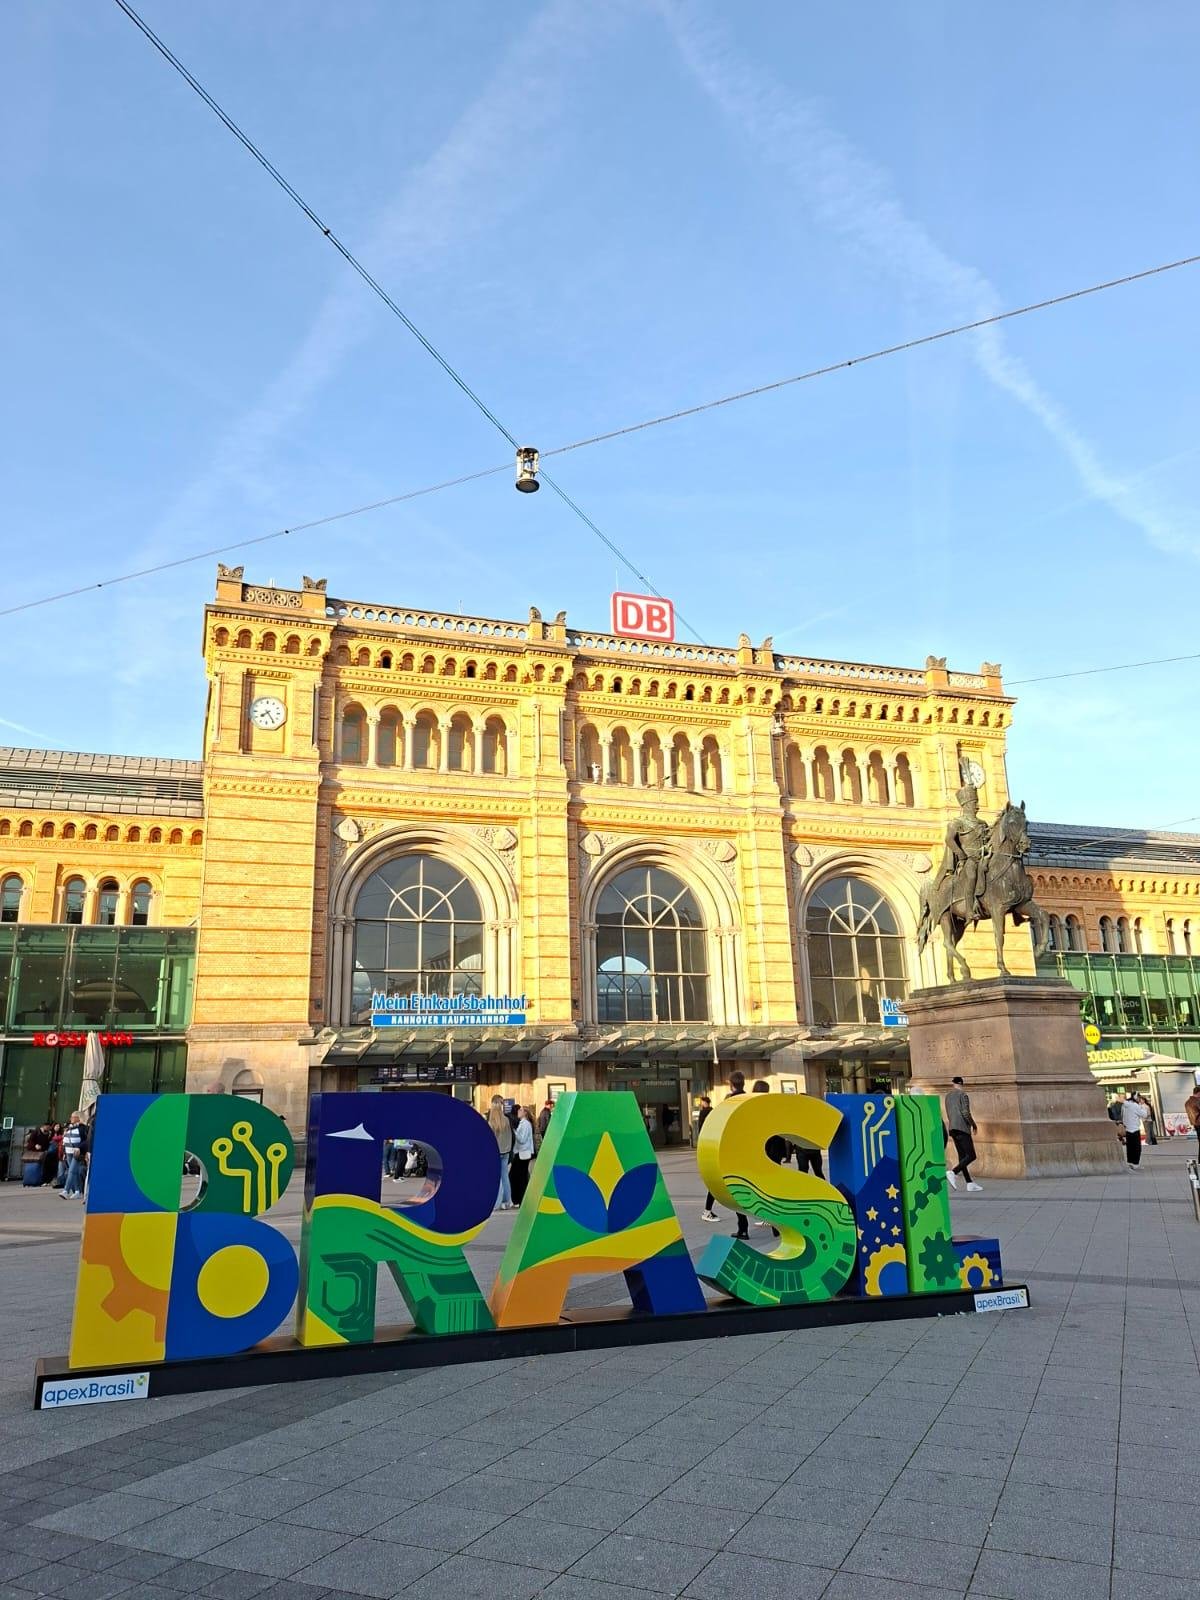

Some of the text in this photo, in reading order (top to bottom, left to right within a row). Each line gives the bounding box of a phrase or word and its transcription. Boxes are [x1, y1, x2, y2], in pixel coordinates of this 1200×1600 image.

[621, 599, 668, 633] DB
[372, 993, 526, 1010] Mein Einkaufsbahnhof
[391, 1014, 510, 1025] HANNOVER HAUPTBAHNHOF
[69, 1091, 1002, 1367] BRASIL
[976, 1293, 1021, 1309] apexBrasil
[44, 1379, 135, 1404] apexBrasil
